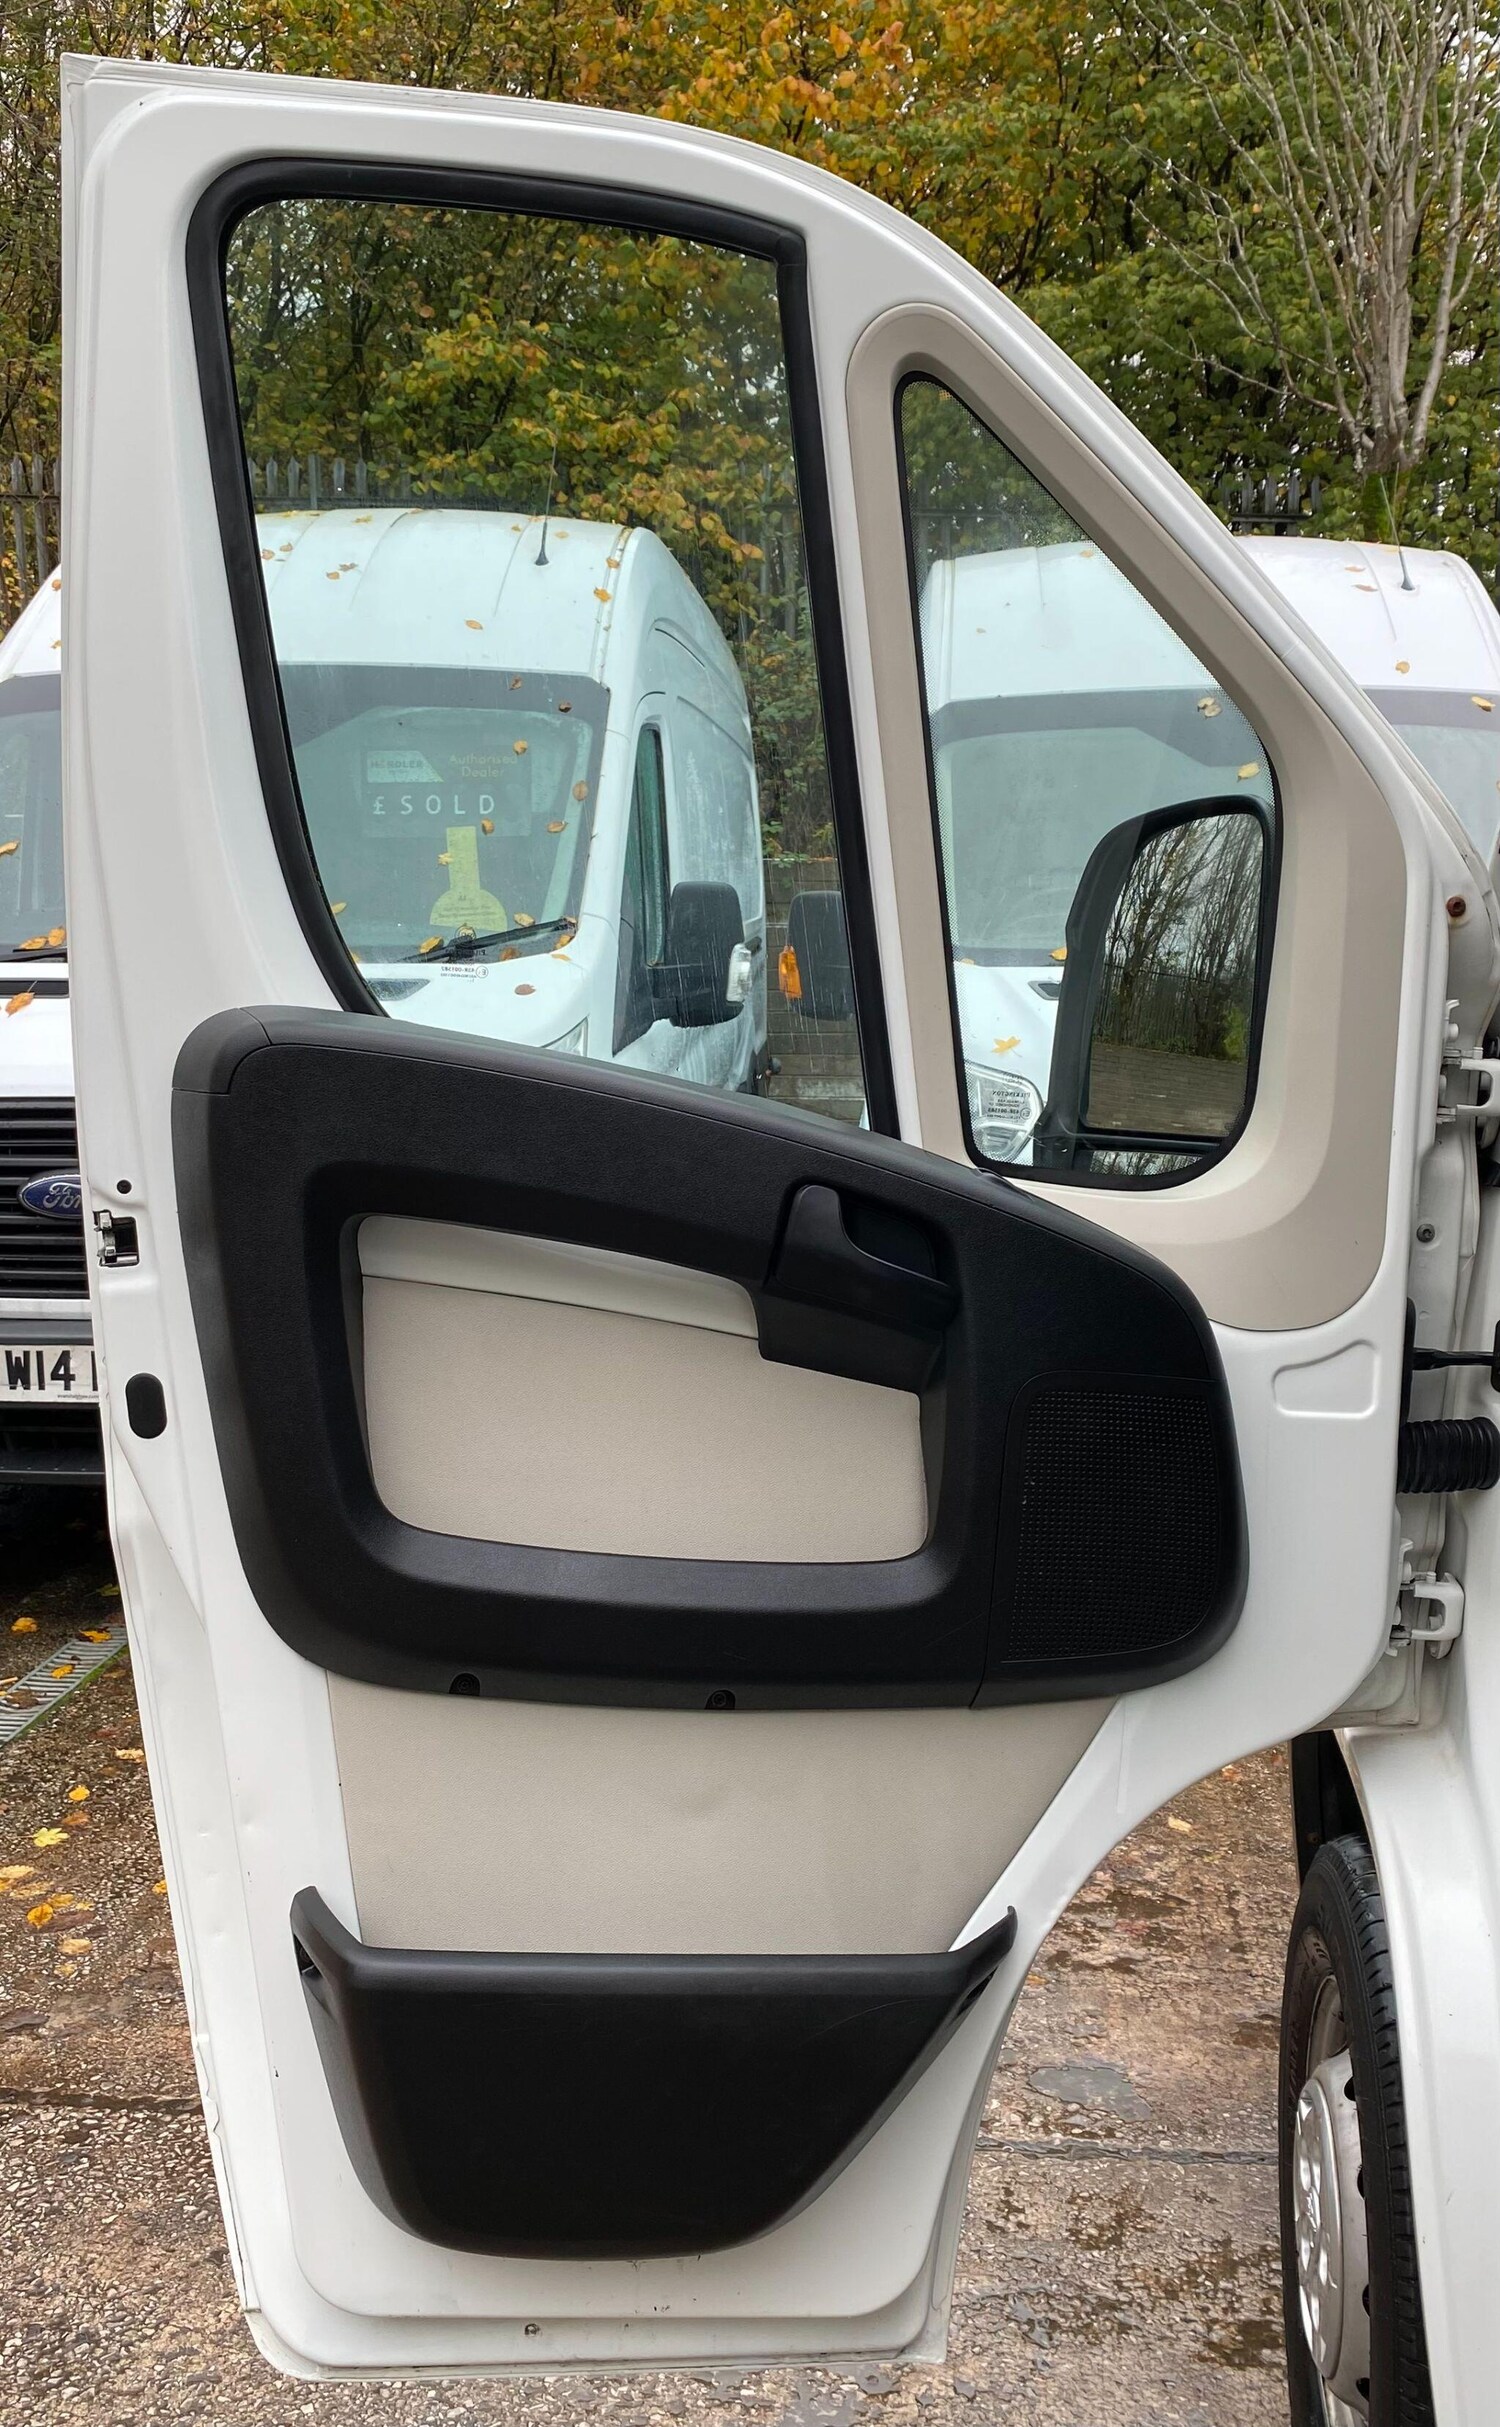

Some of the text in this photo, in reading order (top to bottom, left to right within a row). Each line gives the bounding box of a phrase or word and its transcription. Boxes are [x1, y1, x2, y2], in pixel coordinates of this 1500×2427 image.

[449, 753, 518, 764] Authorised
[462, 765, 505, 777] Dealer
[42, 1182, 82, 1209] For
